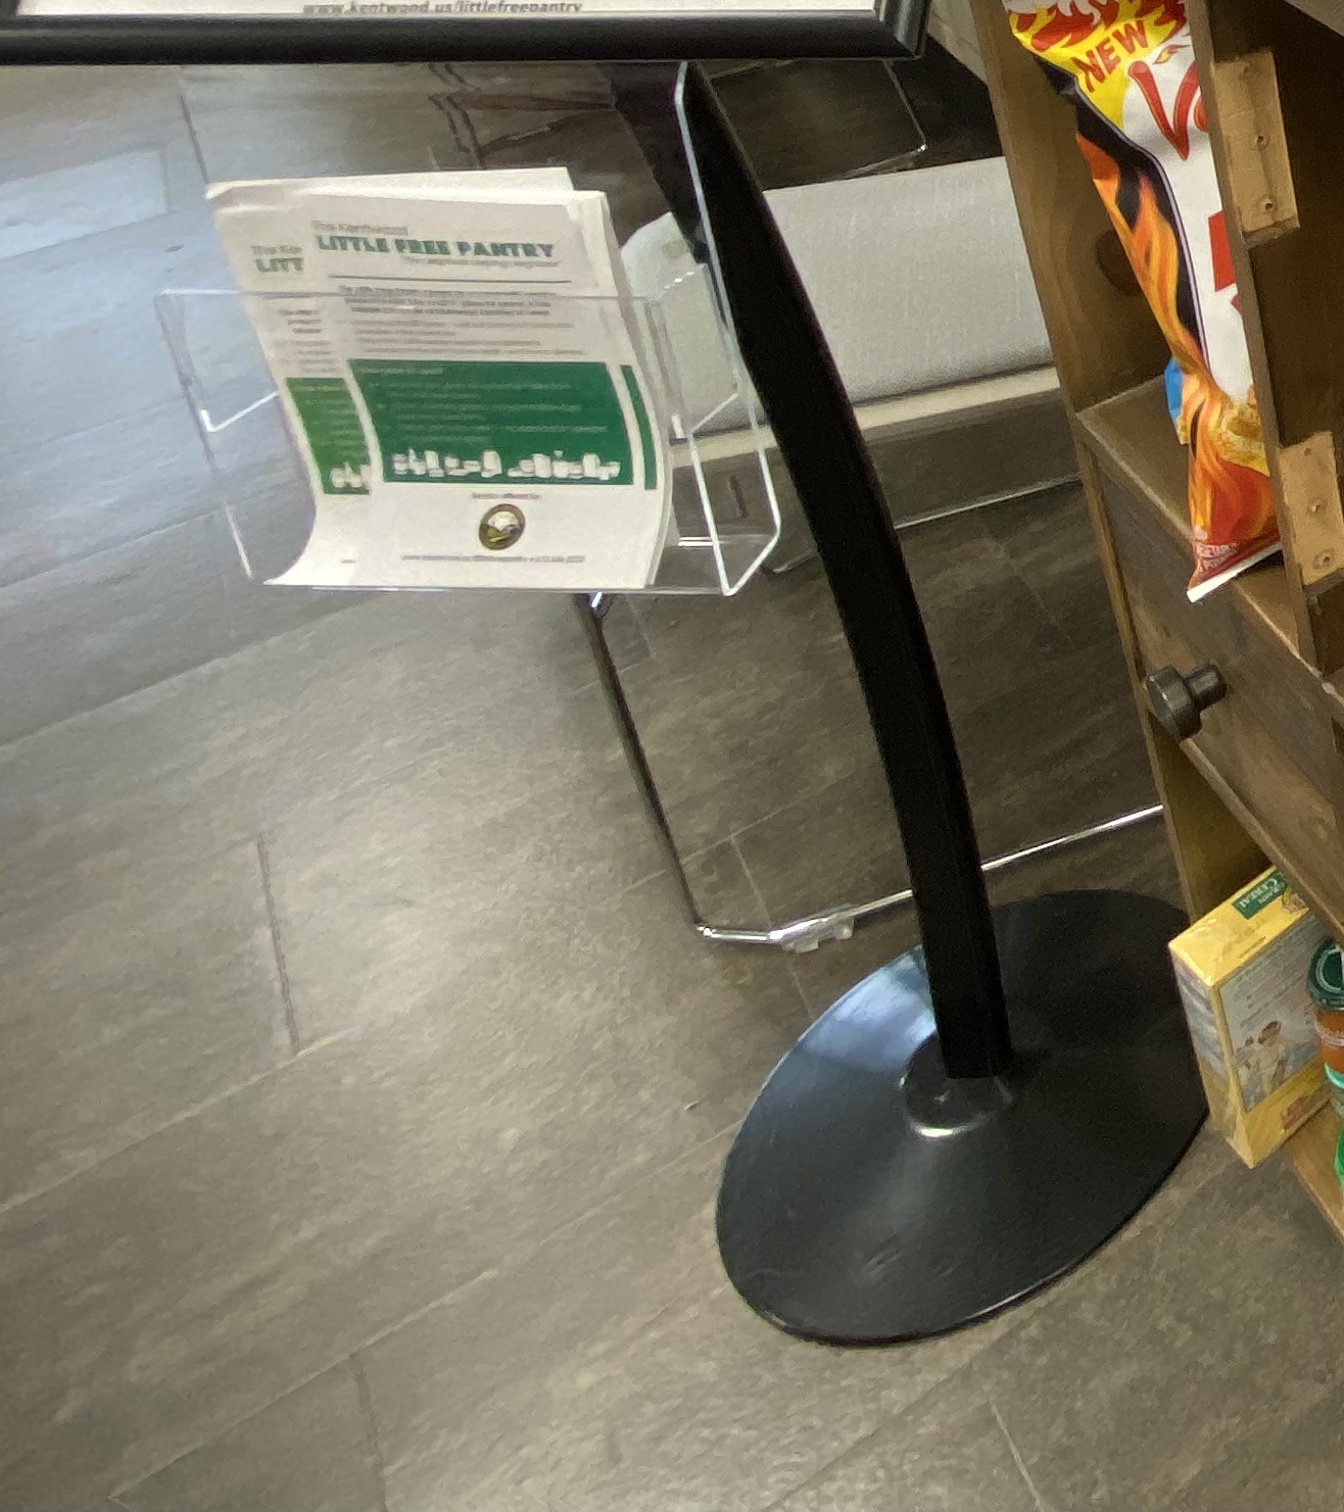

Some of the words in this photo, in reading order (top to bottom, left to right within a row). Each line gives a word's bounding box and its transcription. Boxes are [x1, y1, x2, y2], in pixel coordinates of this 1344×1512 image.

[1072, 18, 1150, 93] NEW
[316, 235, 390, 253] LITTLE
[456, 240, 554, 258] PANTRY
